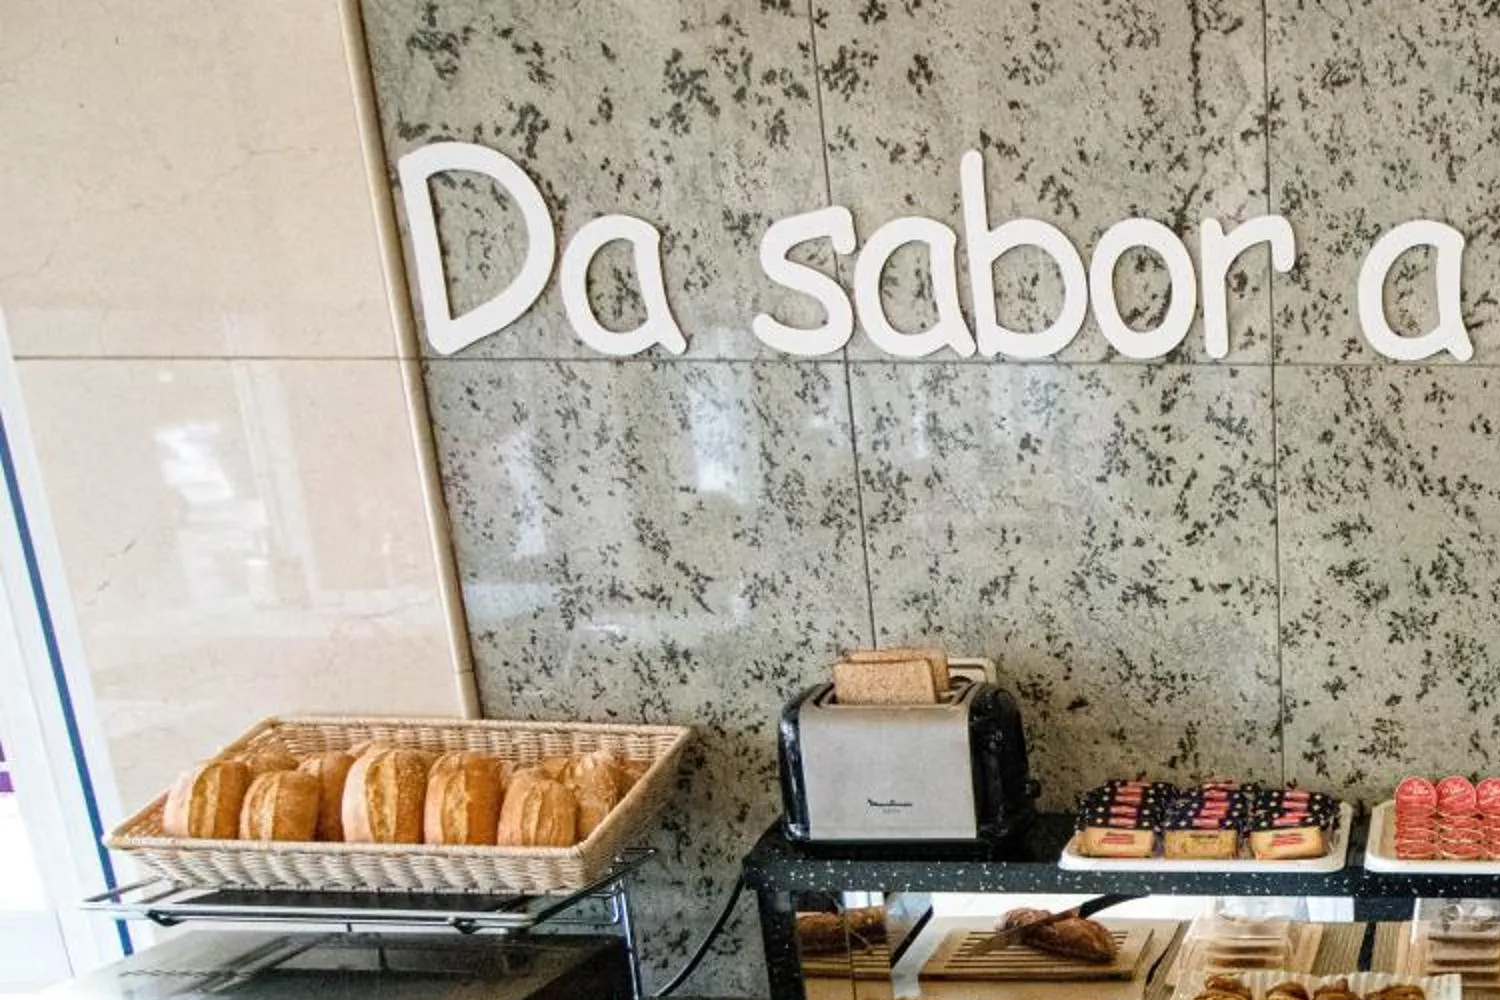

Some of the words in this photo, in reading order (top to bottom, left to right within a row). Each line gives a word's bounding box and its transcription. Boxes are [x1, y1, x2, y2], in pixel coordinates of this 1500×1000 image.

[399, 141, 688, 358] Da
[752, 149, 1296, 361] sabor
[1357, 219, 1473, 362] a
